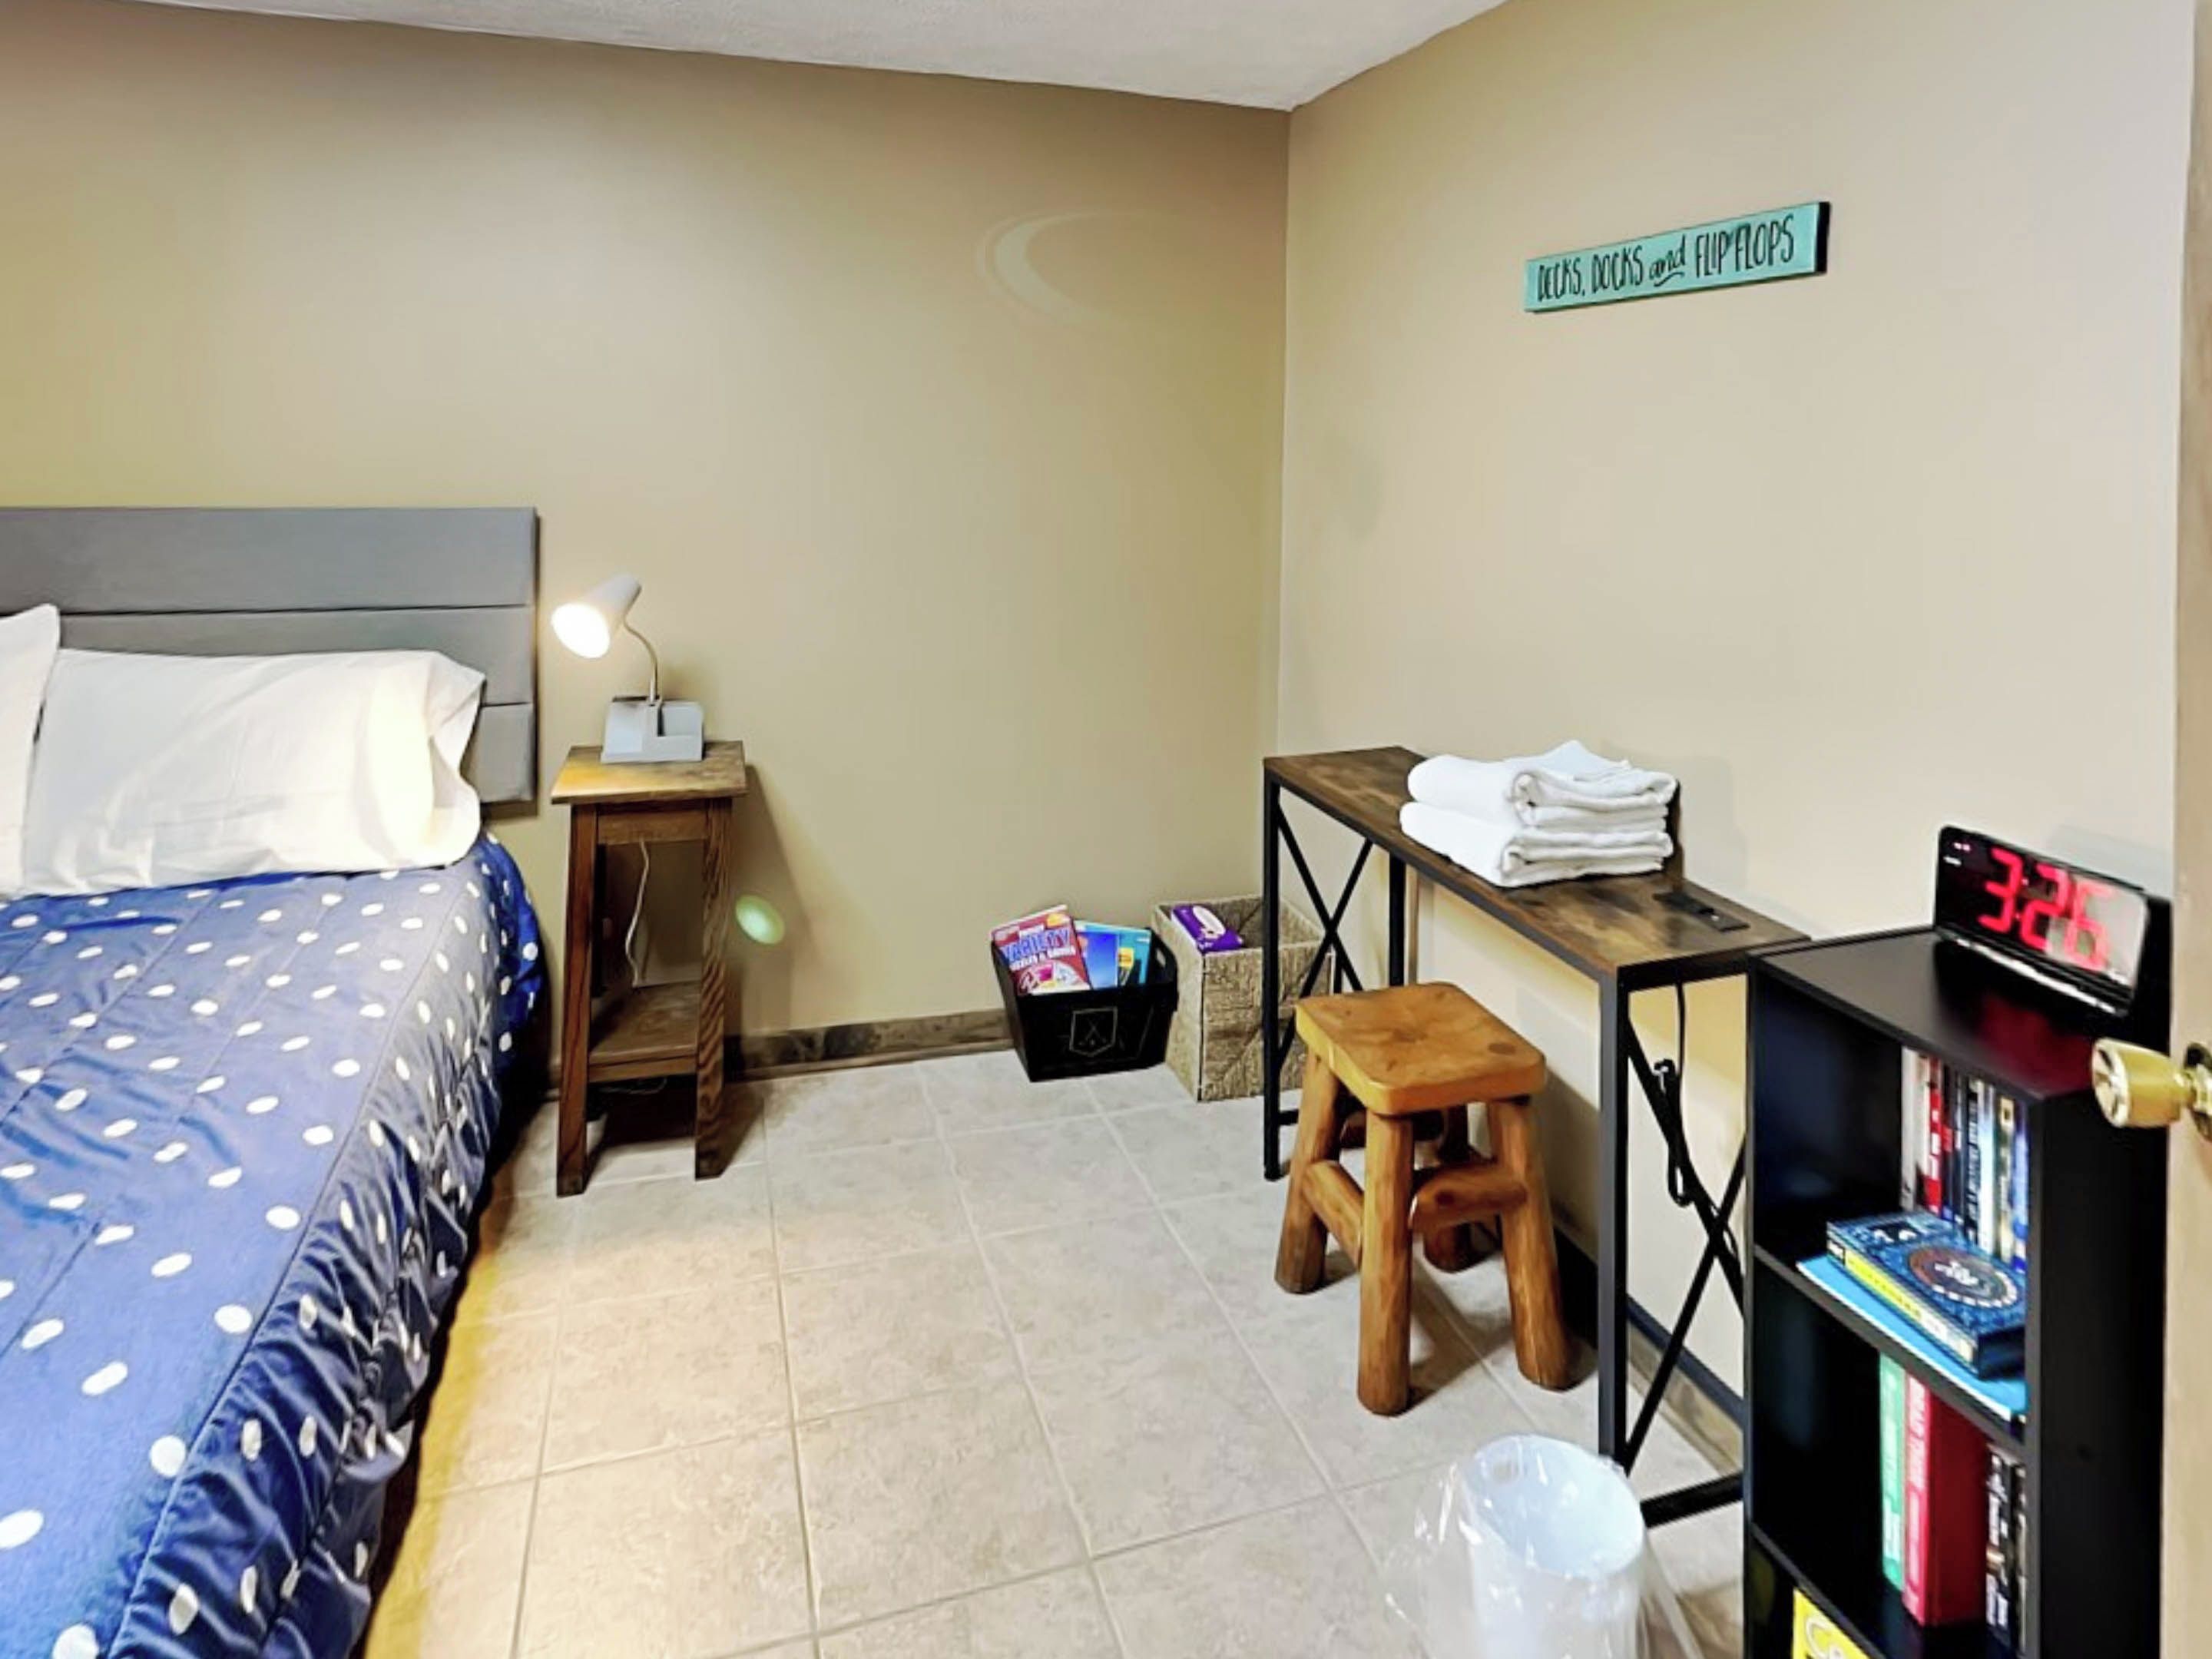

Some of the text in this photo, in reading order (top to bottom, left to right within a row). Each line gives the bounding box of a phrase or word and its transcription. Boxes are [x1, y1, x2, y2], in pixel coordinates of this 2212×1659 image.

[1538, 257, 1585, 302] DECKS,
[1591, 245, 1643, 293] DOCKS
[1649, 233, 1686, 286] and
[1976, 847, 2117, 972] 3:26
